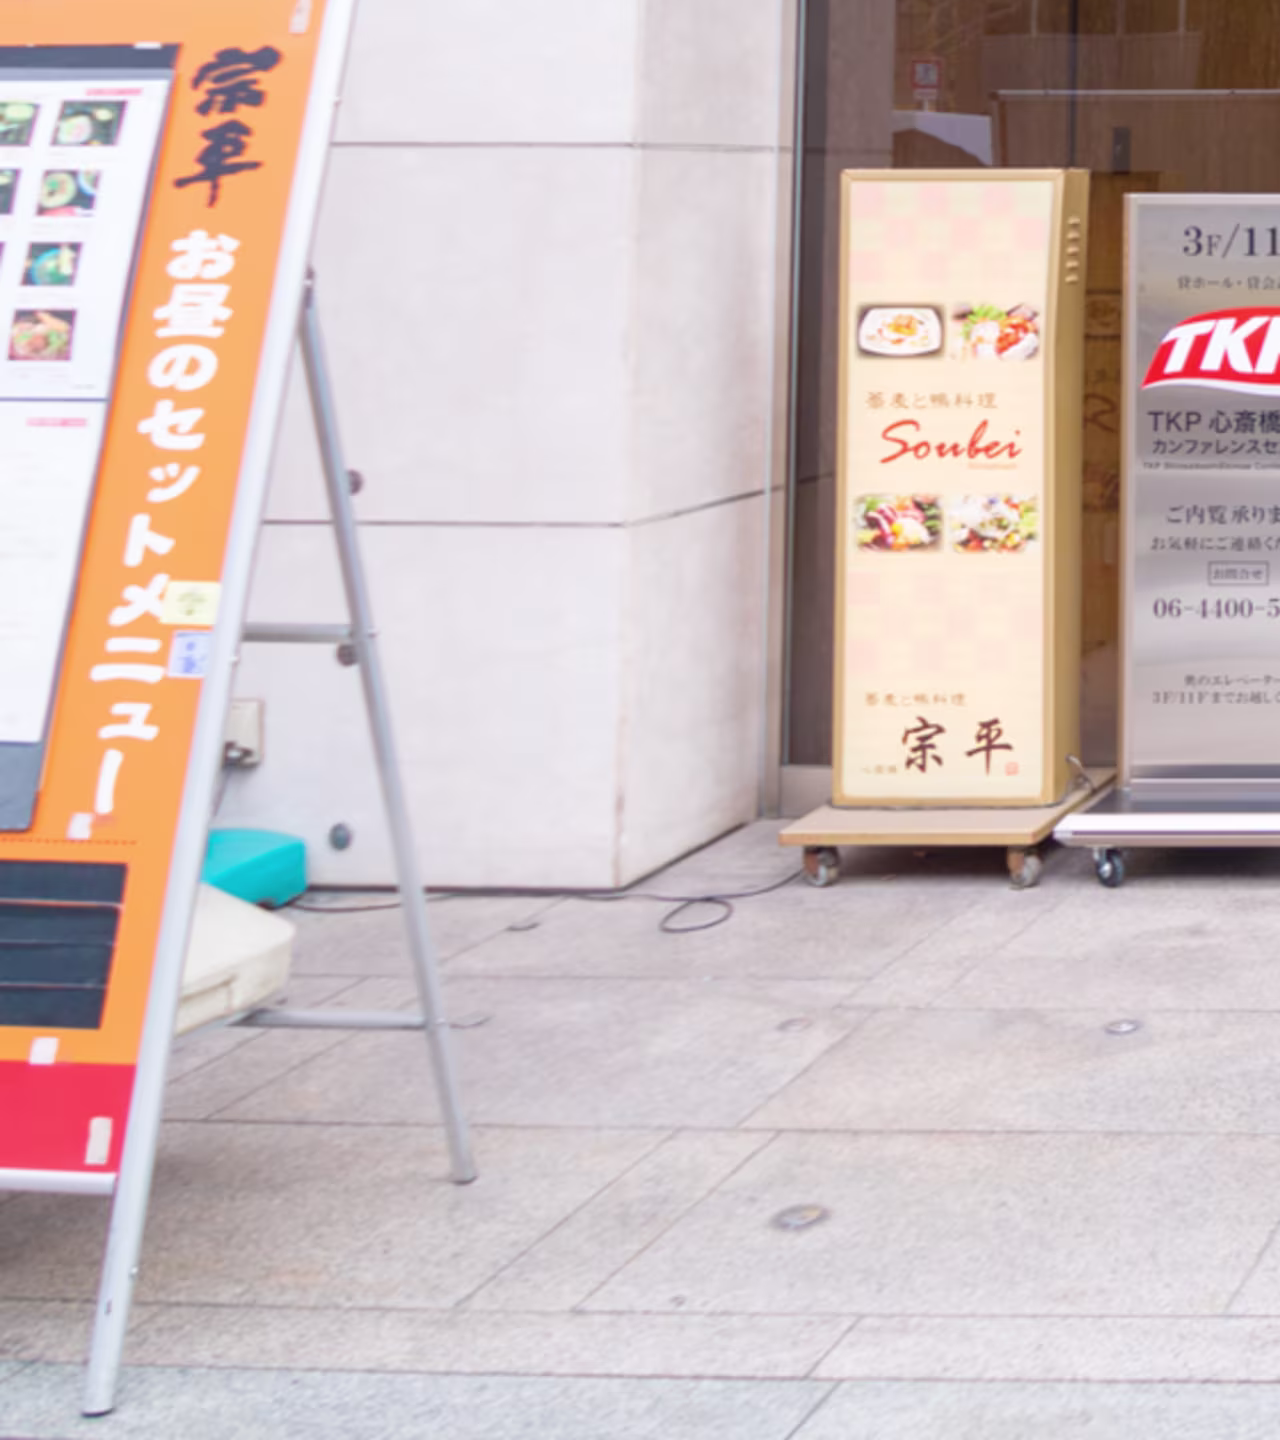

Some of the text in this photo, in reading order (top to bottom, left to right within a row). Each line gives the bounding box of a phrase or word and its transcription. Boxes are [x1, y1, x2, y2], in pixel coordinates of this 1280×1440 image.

[879, 419, 1023, 464] Soubei
[1147, 410, 1202, 433] TKP
[89, 228, 241, 815] お昼のセットメニュー
[901, 715, 1014, 776] 宗平
